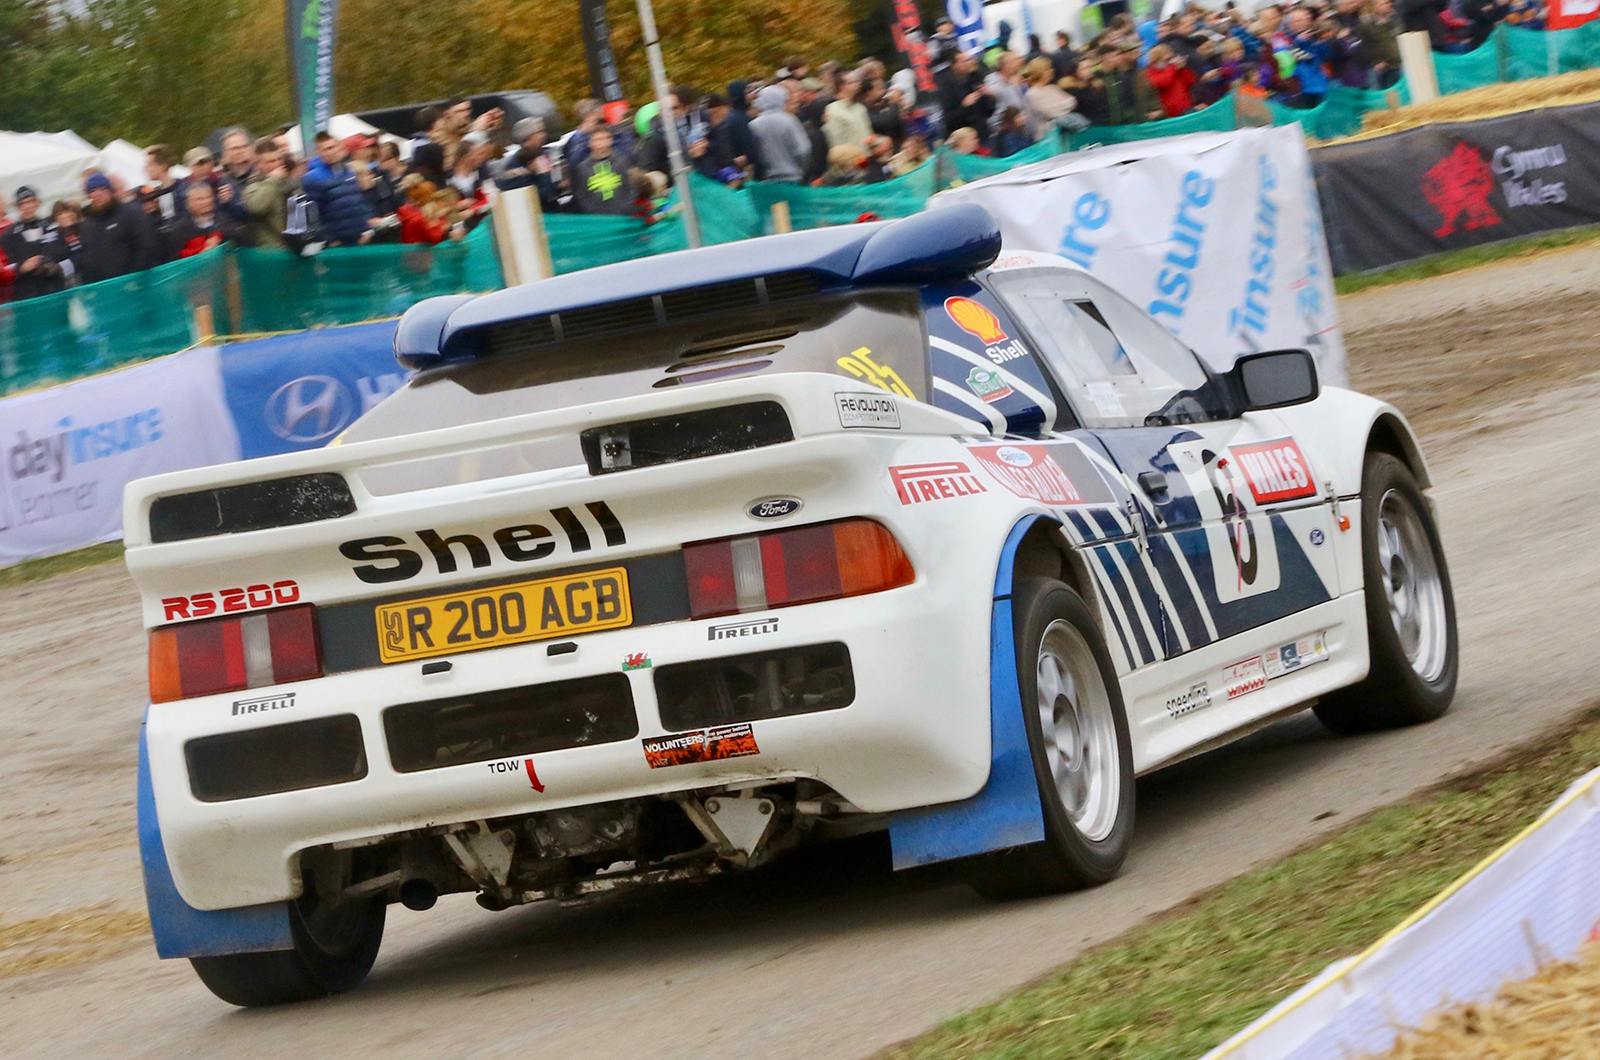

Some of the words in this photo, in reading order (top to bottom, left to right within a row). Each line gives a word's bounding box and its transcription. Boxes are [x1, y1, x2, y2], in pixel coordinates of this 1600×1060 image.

[985, 339, 1029, 364] Shell
[840, 399, 896, 412] REVOLUTION
[1238, 446, 1309, 495] WALES
[888, 461, 988, 506] PIRELLI
[759, 501, 790, 516] Ford
[338, 500, 627, 584] Shell
[407, 606, 435, 650] R
[443, 592, 527, 644] 200
[540, 577, 622, 630] AGB
[708, 617, 779, 641] PIRELLI
[231, 692, 296, 716] PIRELLI
[1166, 684, 1212, 720] speedline
[645, 734, 703, 753] VOLUNTEERS
[487, 759, 519, 774] TOW
